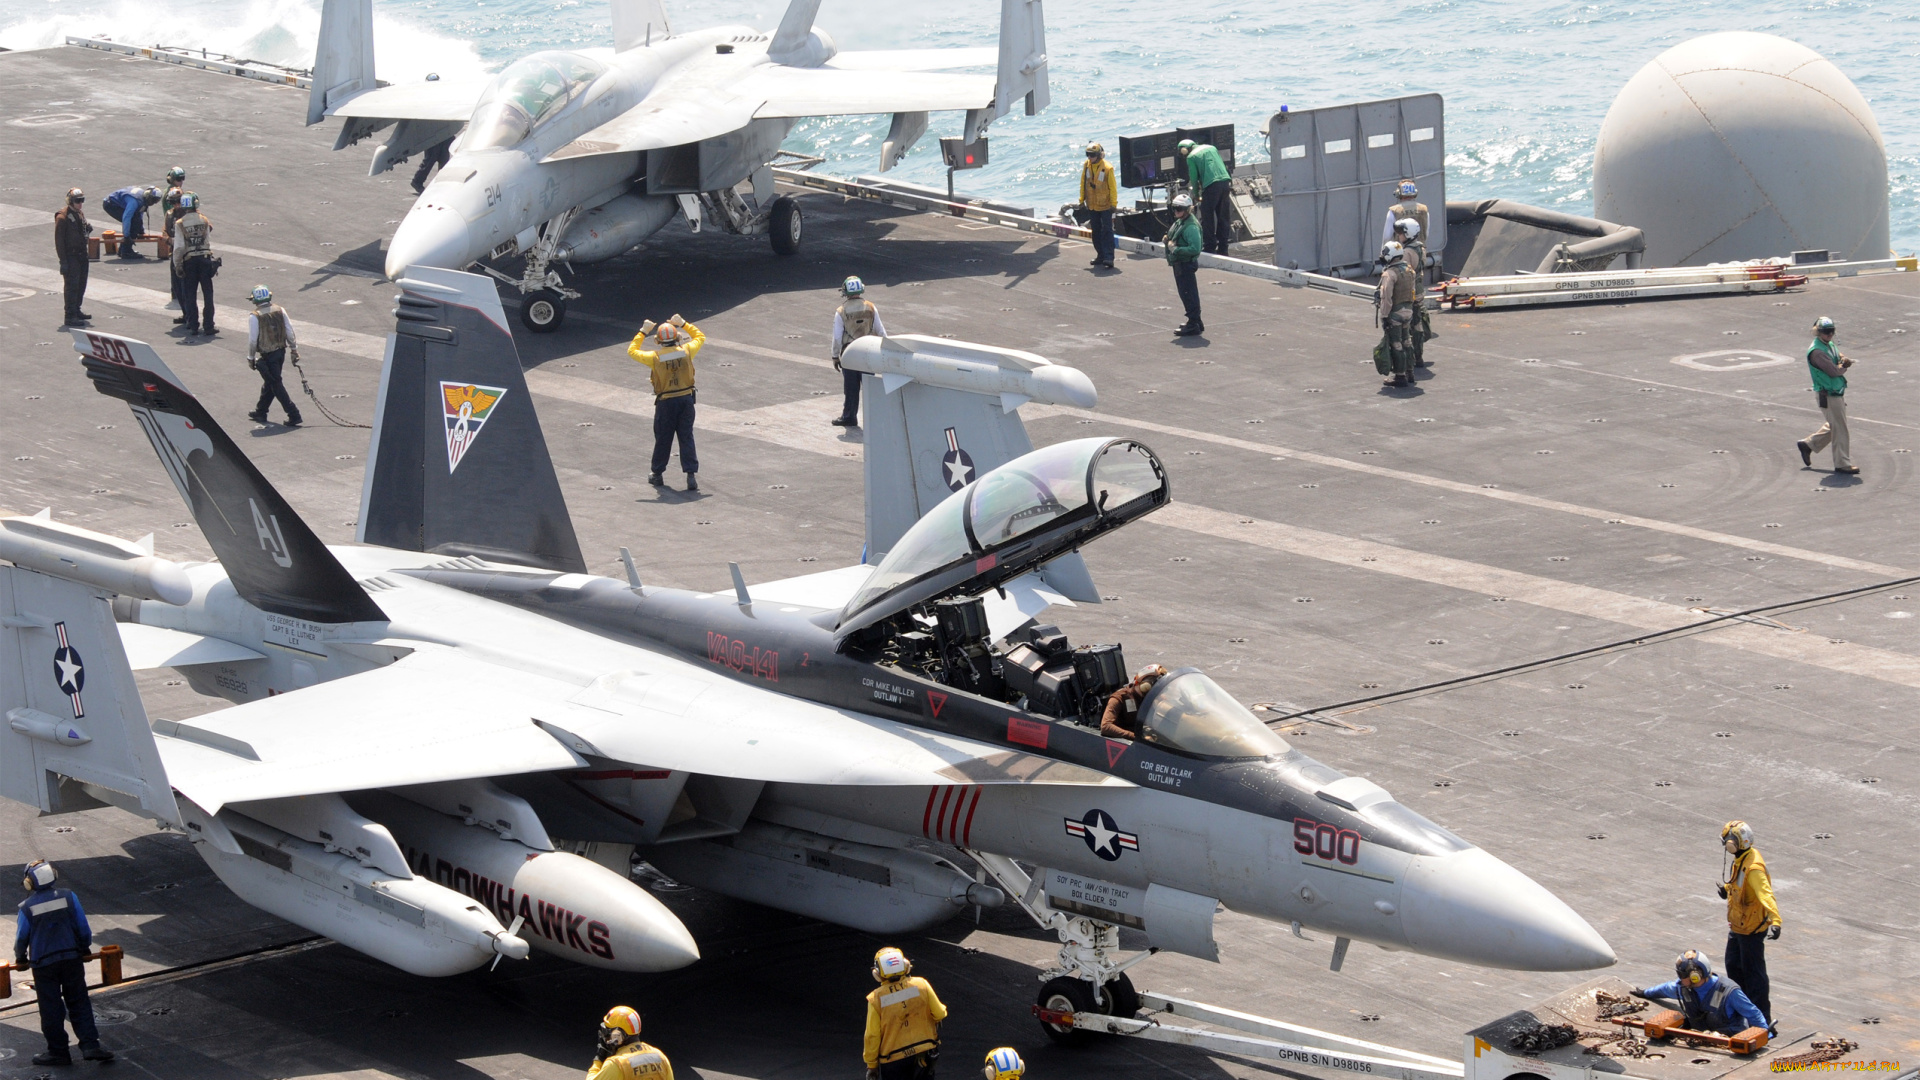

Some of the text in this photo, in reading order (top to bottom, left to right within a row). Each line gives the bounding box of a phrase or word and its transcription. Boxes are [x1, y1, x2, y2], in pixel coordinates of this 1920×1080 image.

[484, 183, 502, 207] 214
[847, 280, 862, 291] 21
[1555, 278, 1635, 290] GPNB S/N D98055
[1572, 292, 1594, 300] GPNB
[1595, 291, 1608, 299] S/N
[86, 333, 136, 367] 500
[248, 497, 293, 568] AJ
[707, 631, 779, 682] VAQ-141
[862, 678, 915, 698] CDR MIKE MILLER
[874, 690, 898, 702] OUTLAW
[1140, 761, 1193, 779] CDR BEN CLARK
[1148, 773, 1181, 787] OUTLAW 2
[1294, 817, 1362, 866] 500
[1070, 879, 1082, 888] PRC
[1085, 883, 1109, 894] (AW/SW)
[1112, 888, 1129, 899] TRACY
[1072, 890, 1083, 899] BOX
[1109, 898, 1117, 907] SD
[400, 843, 615, 960] ADOWHAWKS
[889, 981, 905, 993] FLY
[633, 1065, 647, 1075] FLT
[1279, 1049, 1372, 1073] GPNB S/N D98056
